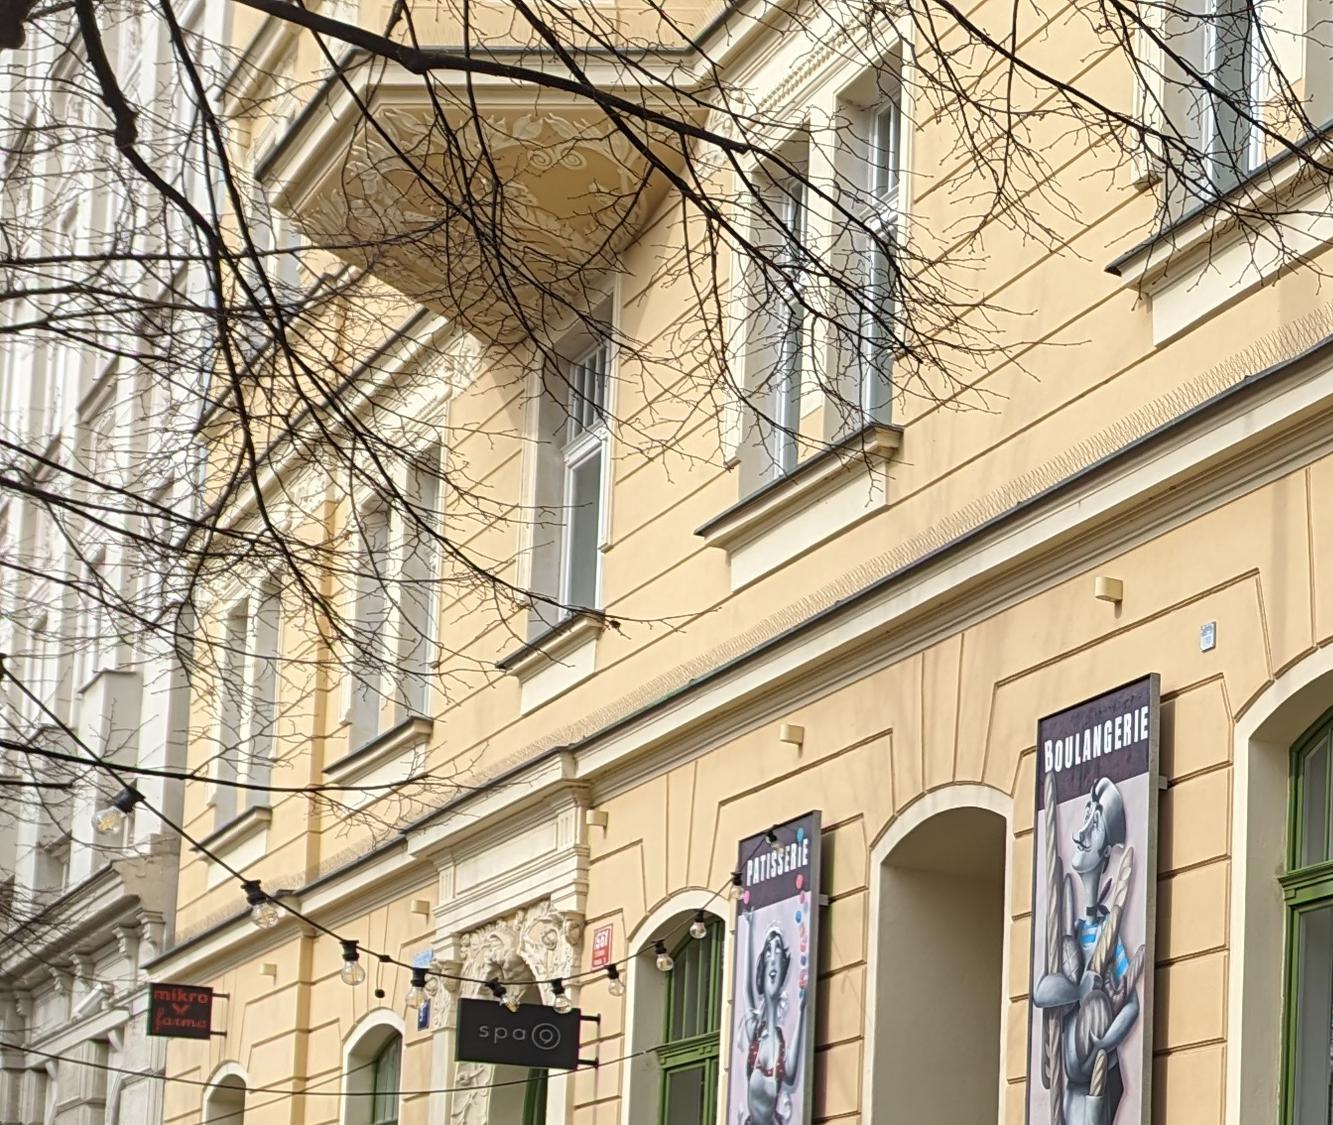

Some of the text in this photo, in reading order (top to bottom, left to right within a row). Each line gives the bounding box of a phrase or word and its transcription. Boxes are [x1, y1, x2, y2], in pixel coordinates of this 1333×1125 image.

[1044, 705, 1149, 773] BOULANGERIE
[746, 838, 809, 886] PATISSERIE
[154, 988, 209, 1004] mikro
